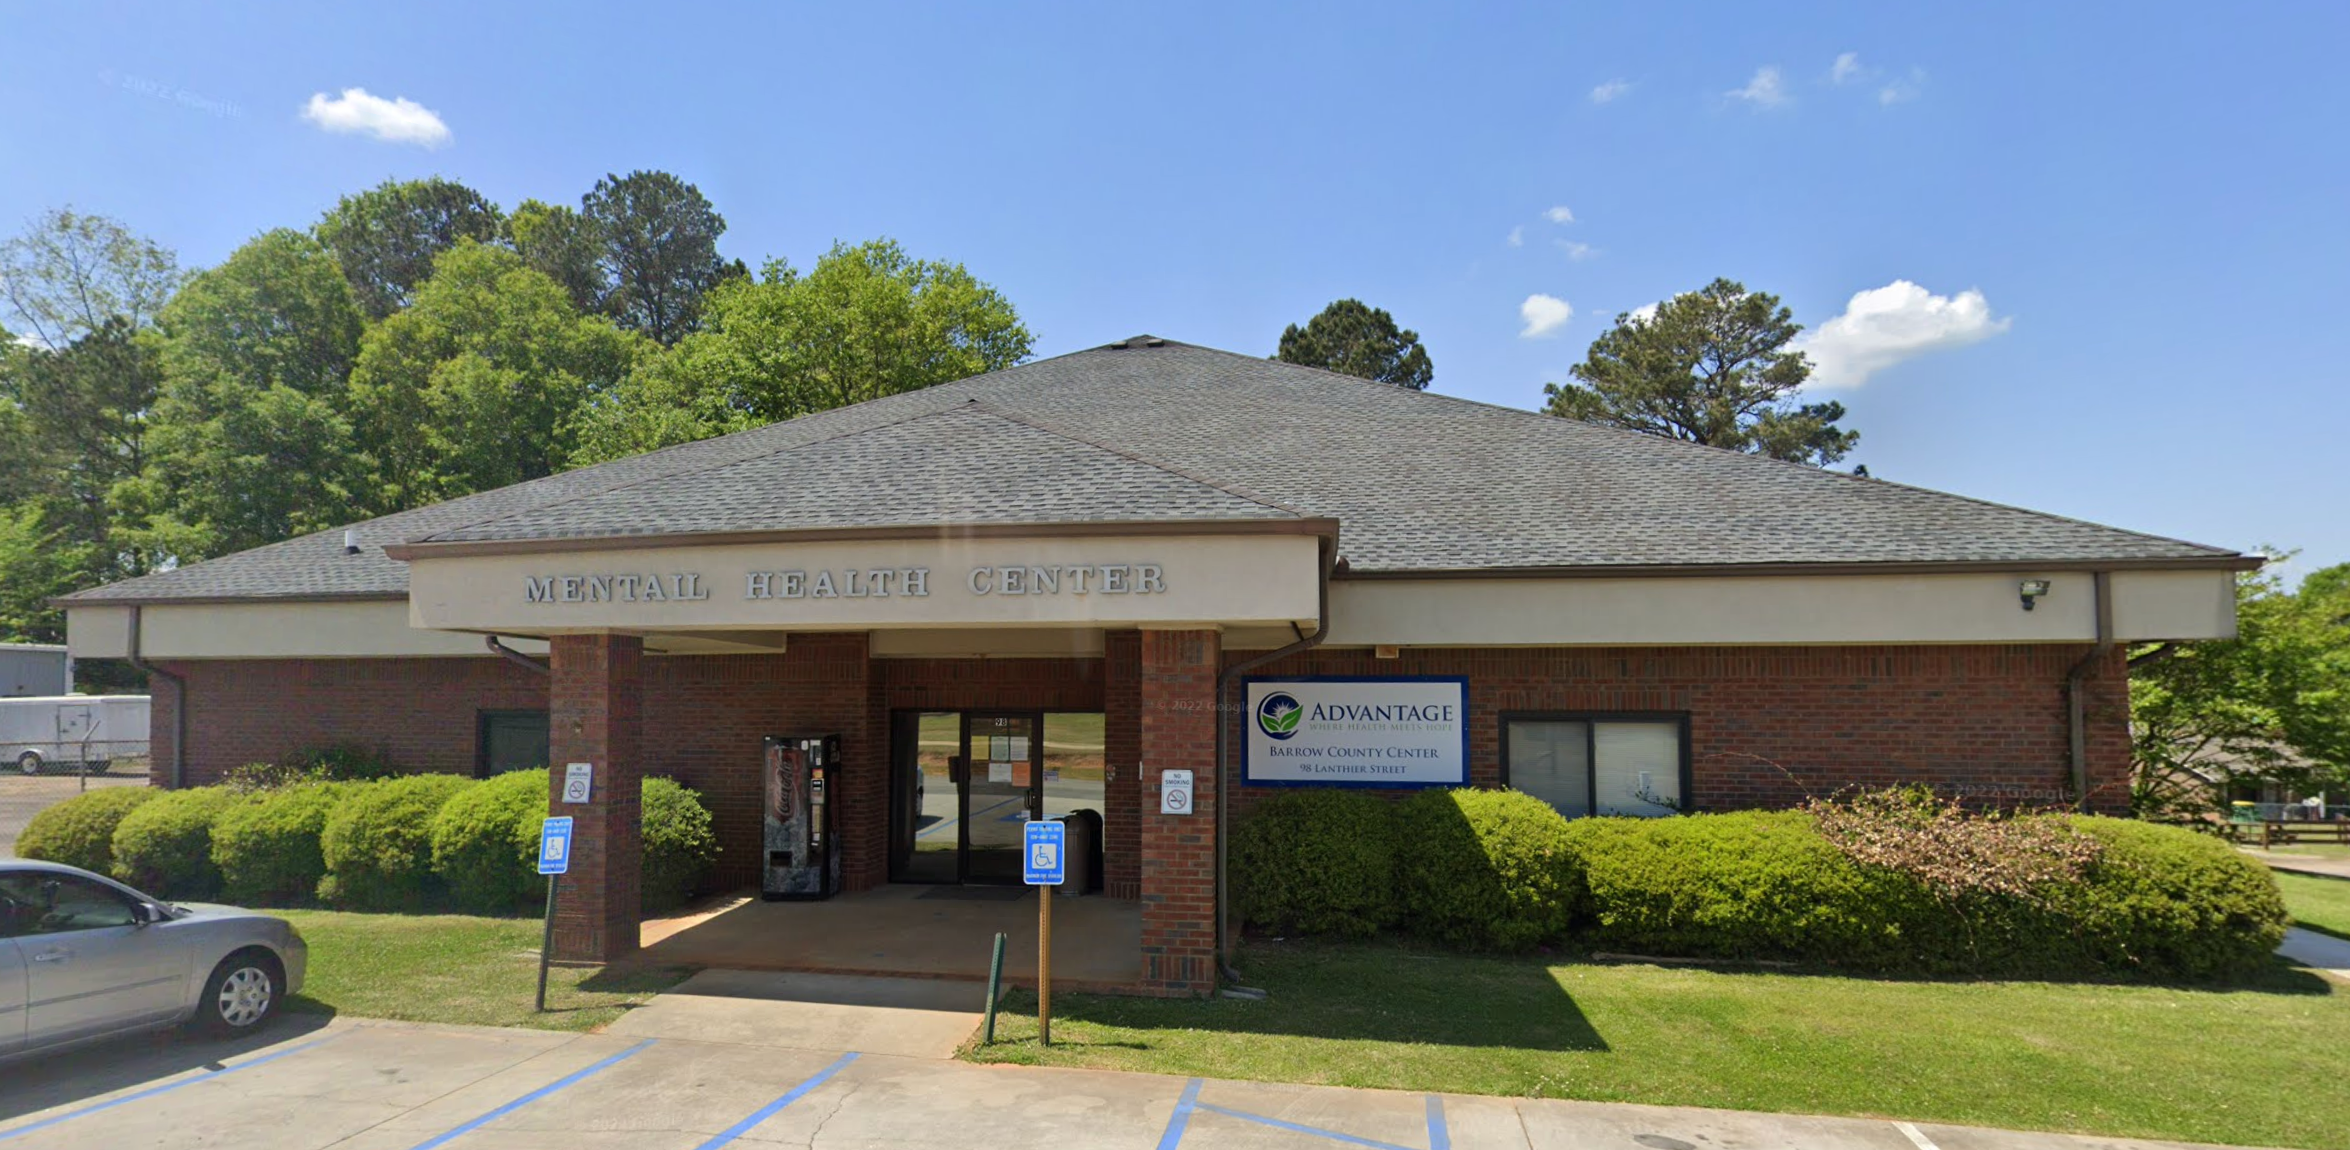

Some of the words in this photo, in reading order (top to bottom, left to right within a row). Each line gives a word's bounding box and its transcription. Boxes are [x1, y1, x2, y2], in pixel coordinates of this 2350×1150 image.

[744, 568, 930, 599] HEALTH
[966, 564, 1166, 595] CENTER
[1309, 702, 1453, 721] ADVANTAGE
[996, 718, 1007, 726] 98
[1309, 723, 1344, 731] WHERE
[1348, 723, 1386, 731] HEALTH
[1390, 723, 1422, 731] MEETS
[1426, 723, 1452, 731] HOPE
[1270, 746, 1323, 757] BARROW
[1327, 746, 1383, 758] COUNTY
[1387, 747, 1439, 758] CENTER
[1300, 764, 1312, 773] 98
[1315, 764, 1367, 774] LANTHIER
[1370, 764, 1407, 774] STREET
